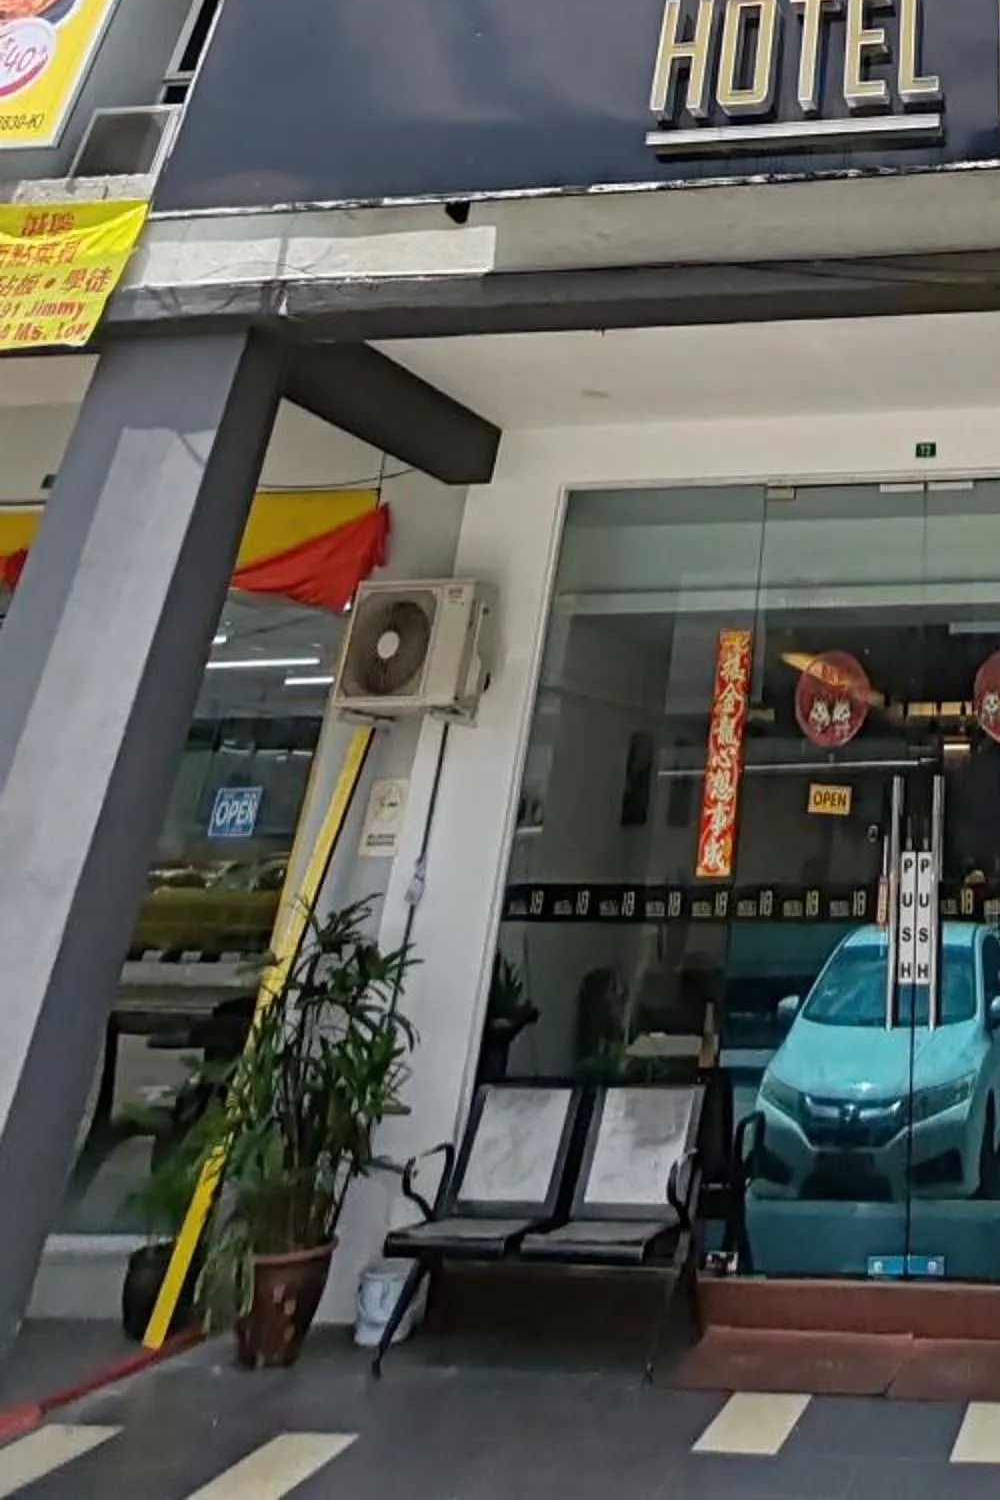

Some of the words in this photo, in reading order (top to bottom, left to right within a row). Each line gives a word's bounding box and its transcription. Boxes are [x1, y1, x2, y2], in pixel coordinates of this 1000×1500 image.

[215, 799, 258, 827] OPEN
[812, 791, 849, 809] OPEN
[901, 857, 913, 978] PUSH
[917, 857, 930, 978] PUSH
